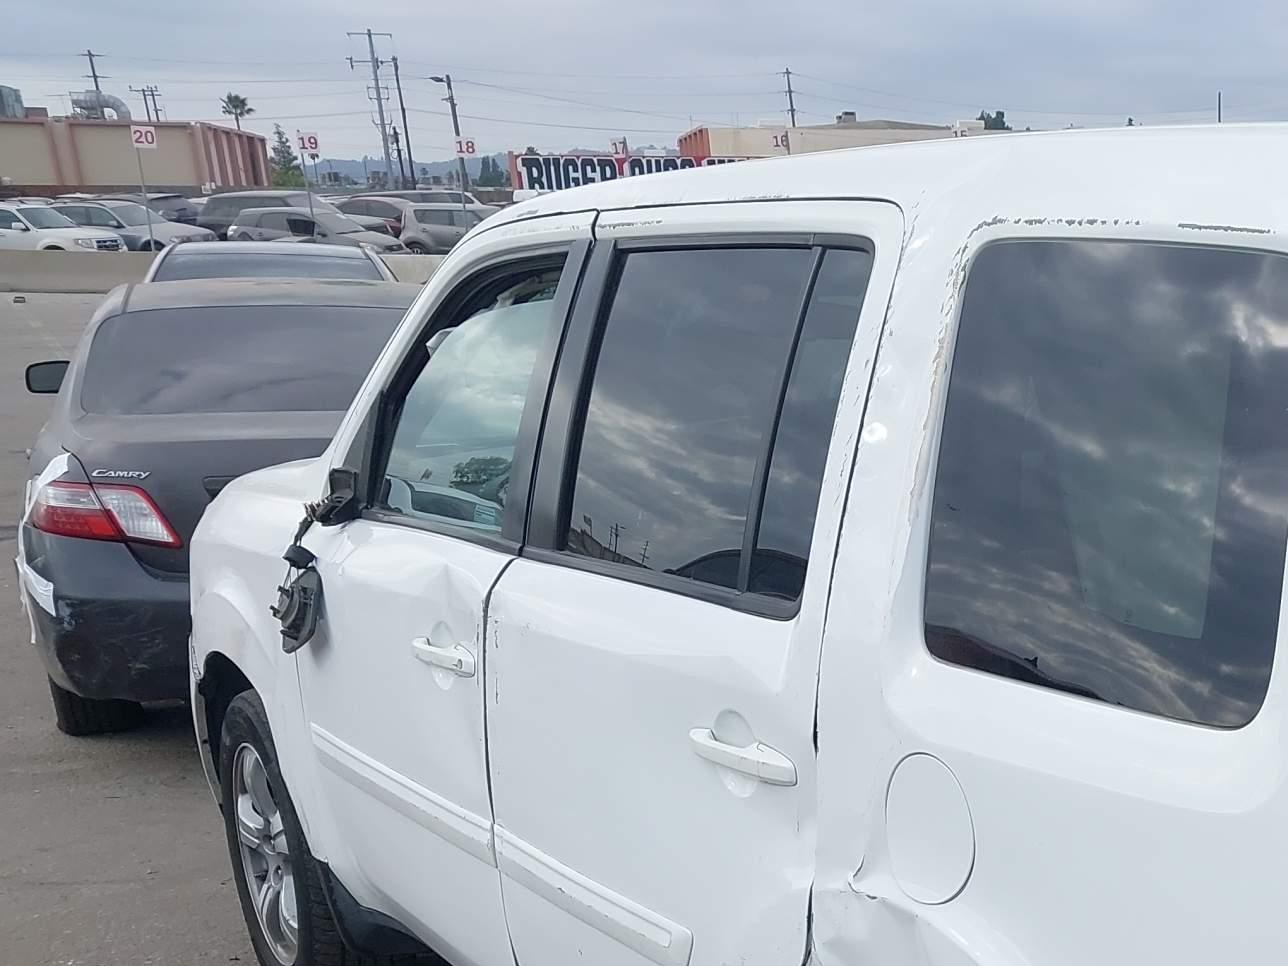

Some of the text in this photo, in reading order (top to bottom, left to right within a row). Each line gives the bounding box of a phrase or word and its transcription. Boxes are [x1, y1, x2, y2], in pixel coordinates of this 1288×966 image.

[133, 129, 155, 145] 20
[299, 136, 318, 150] 19
[773, 135, 789, 147] 16
[456, 140, 475, 154] 18
[612, 141, 626, 155] 17
[91, 469, 151, 479] CAMRY
